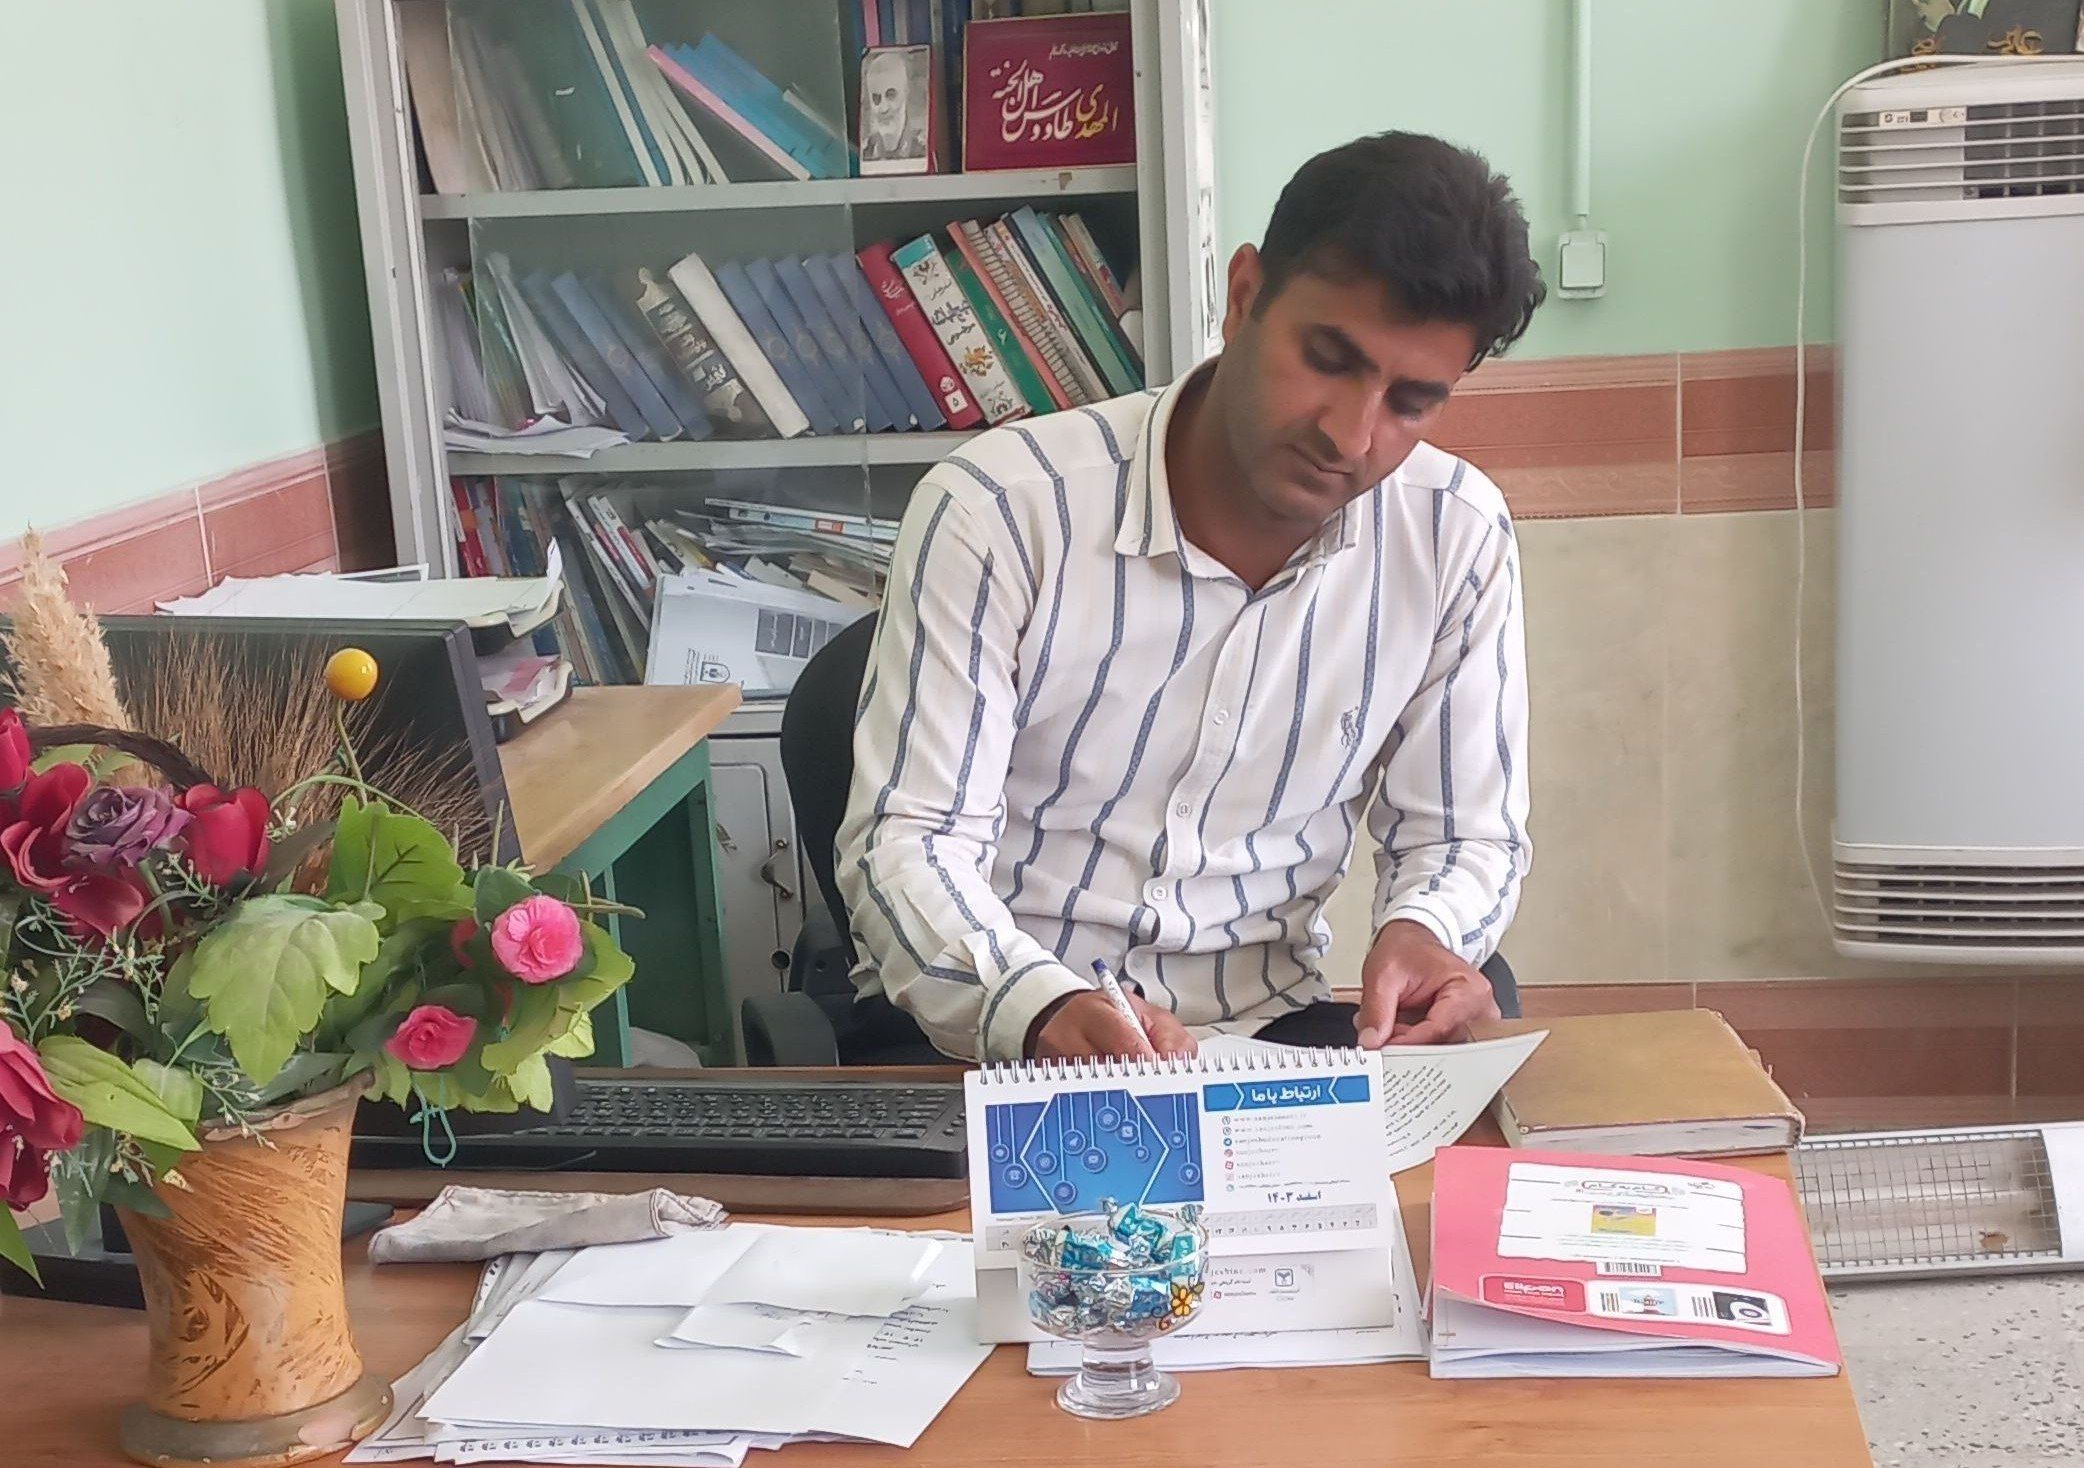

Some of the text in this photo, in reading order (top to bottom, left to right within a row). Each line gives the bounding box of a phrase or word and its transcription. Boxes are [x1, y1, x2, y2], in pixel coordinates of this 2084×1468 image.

[1251, 1084, 1321, 1104] ارتباط با ما
[1267, 1191, 1294, 1203] ۱۴۰۳
